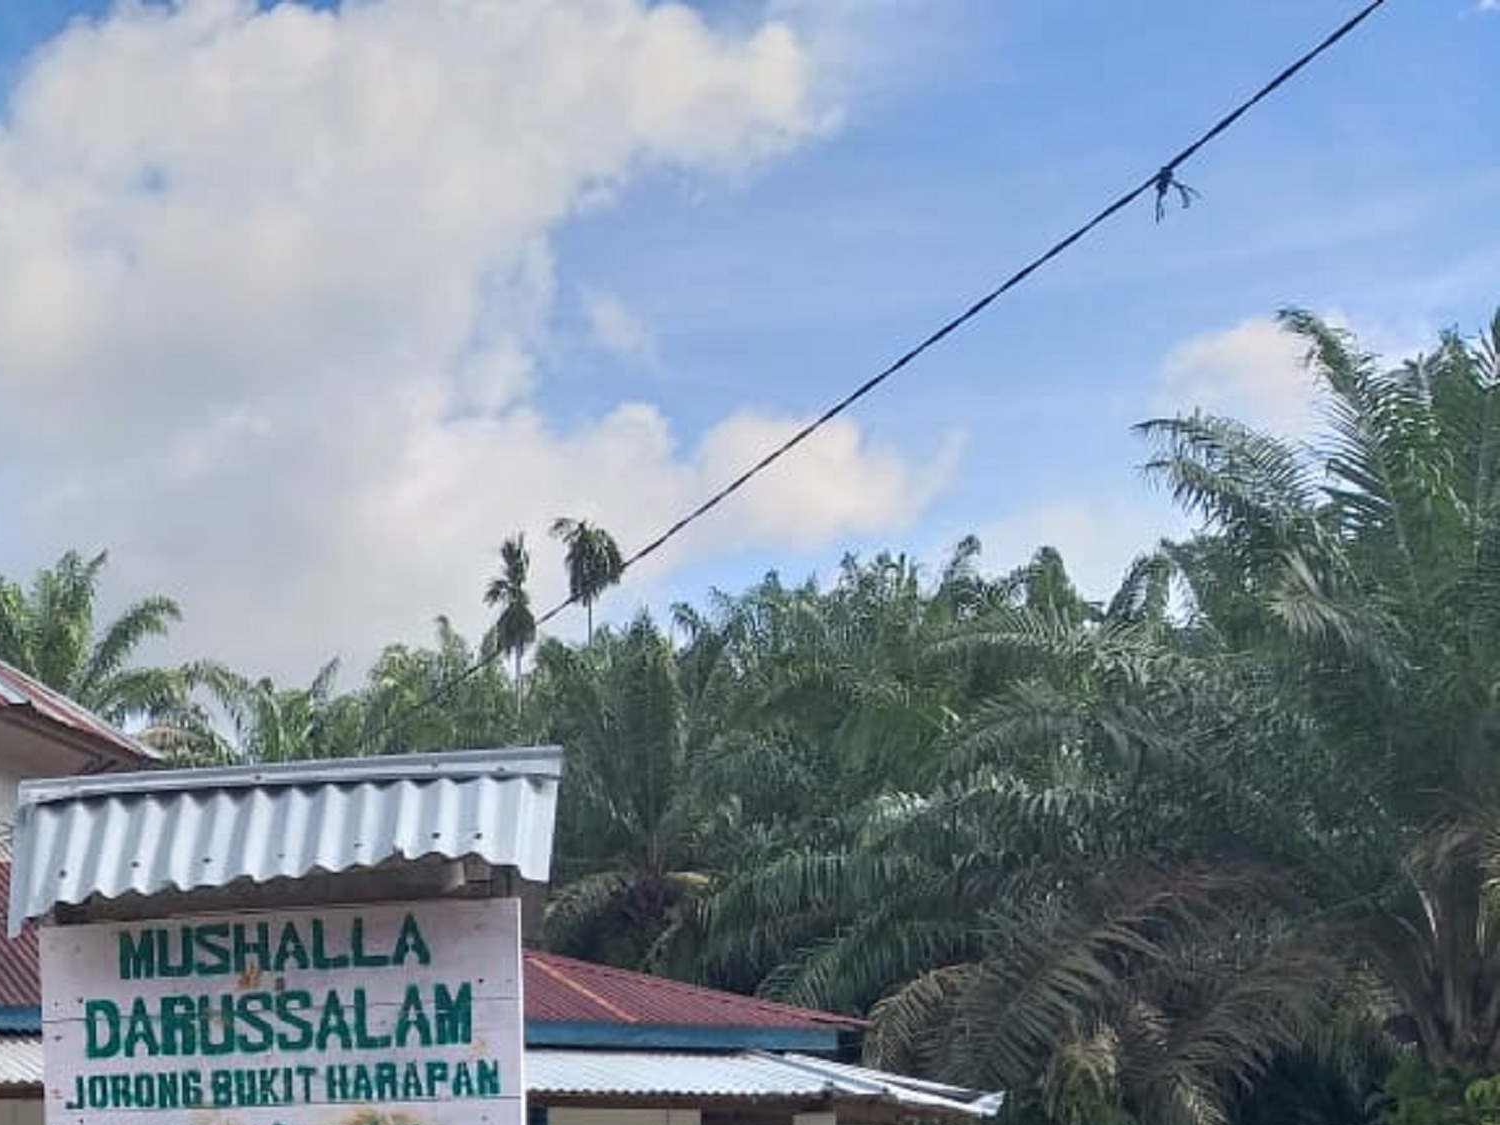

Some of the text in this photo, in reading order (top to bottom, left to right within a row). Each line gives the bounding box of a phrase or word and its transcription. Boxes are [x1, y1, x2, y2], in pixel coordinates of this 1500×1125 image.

[119, 912, 431, 980] MUSHALLA
[84, 982, 473, 1060] DARUSSALAM
[66, 1059, 499, 1110] JORONG BUKIT HARAPAN
